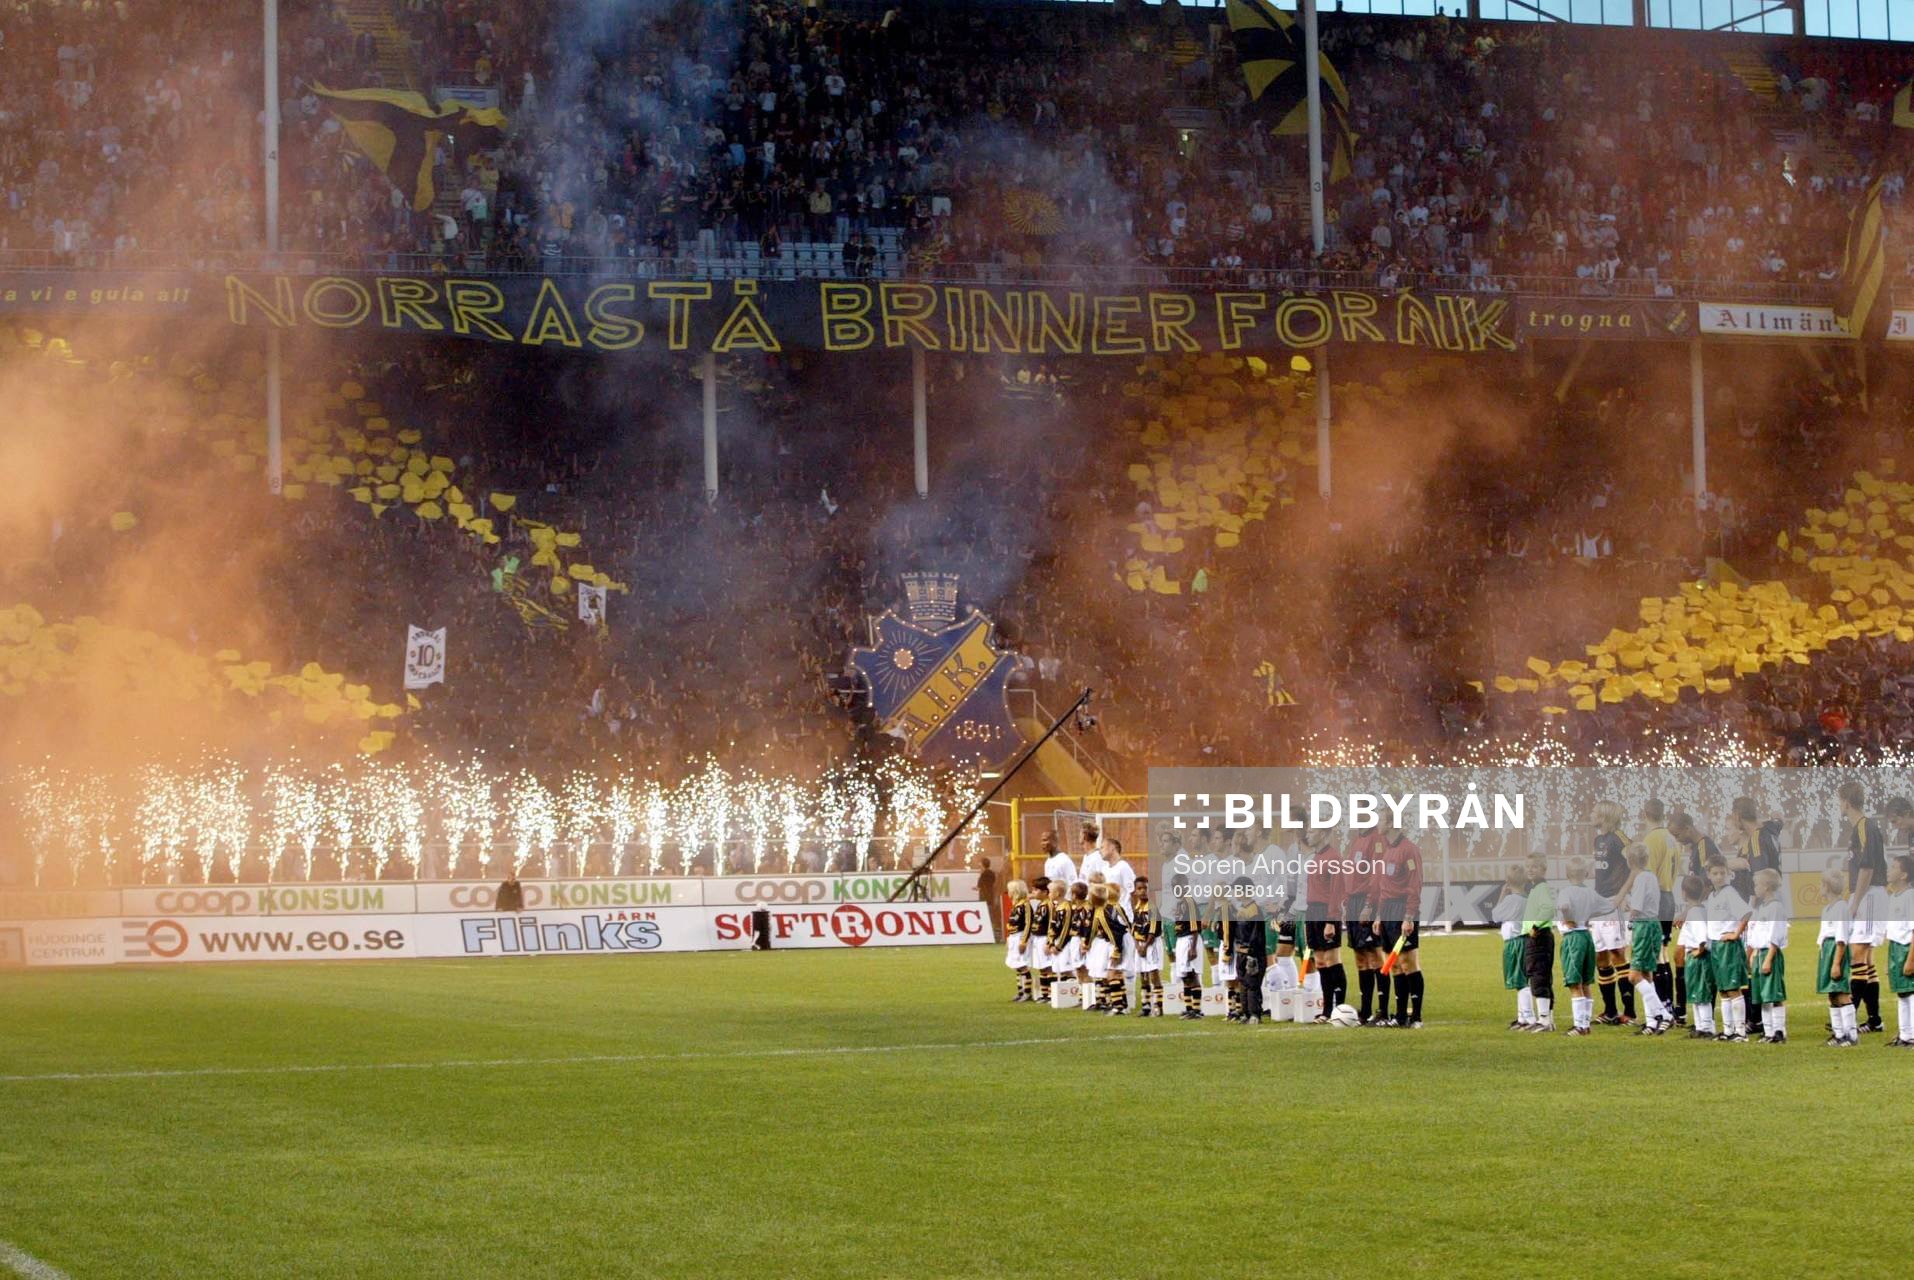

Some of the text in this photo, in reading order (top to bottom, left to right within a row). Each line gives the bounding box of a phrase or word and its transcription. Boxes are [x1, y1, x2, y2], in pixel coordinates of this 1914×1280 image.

[90, 286, 145, 305] gula
[225, 275, 781, 352] NORRASTÅ
[820, 282, 1201, 355] BRINNER
[1215, 288, 1385, 350] FÖR
[1529, 309, 1633, 332] trogna
[417, 644, 435, 668] 10
[955, 719, 1001, 742] 1891
[258, 887, 384, 912] KONSUM
[551, 882, 672, 907] KONSUM
[605, 911, 657, 922] JÄRN
[28, 934, 107, 945] HUDDINGE
[200, 929, 405, 953] www.eo.se
[461, 915, 663, 953] Flinks
[31, 947, 105, 959] CENTRUM
